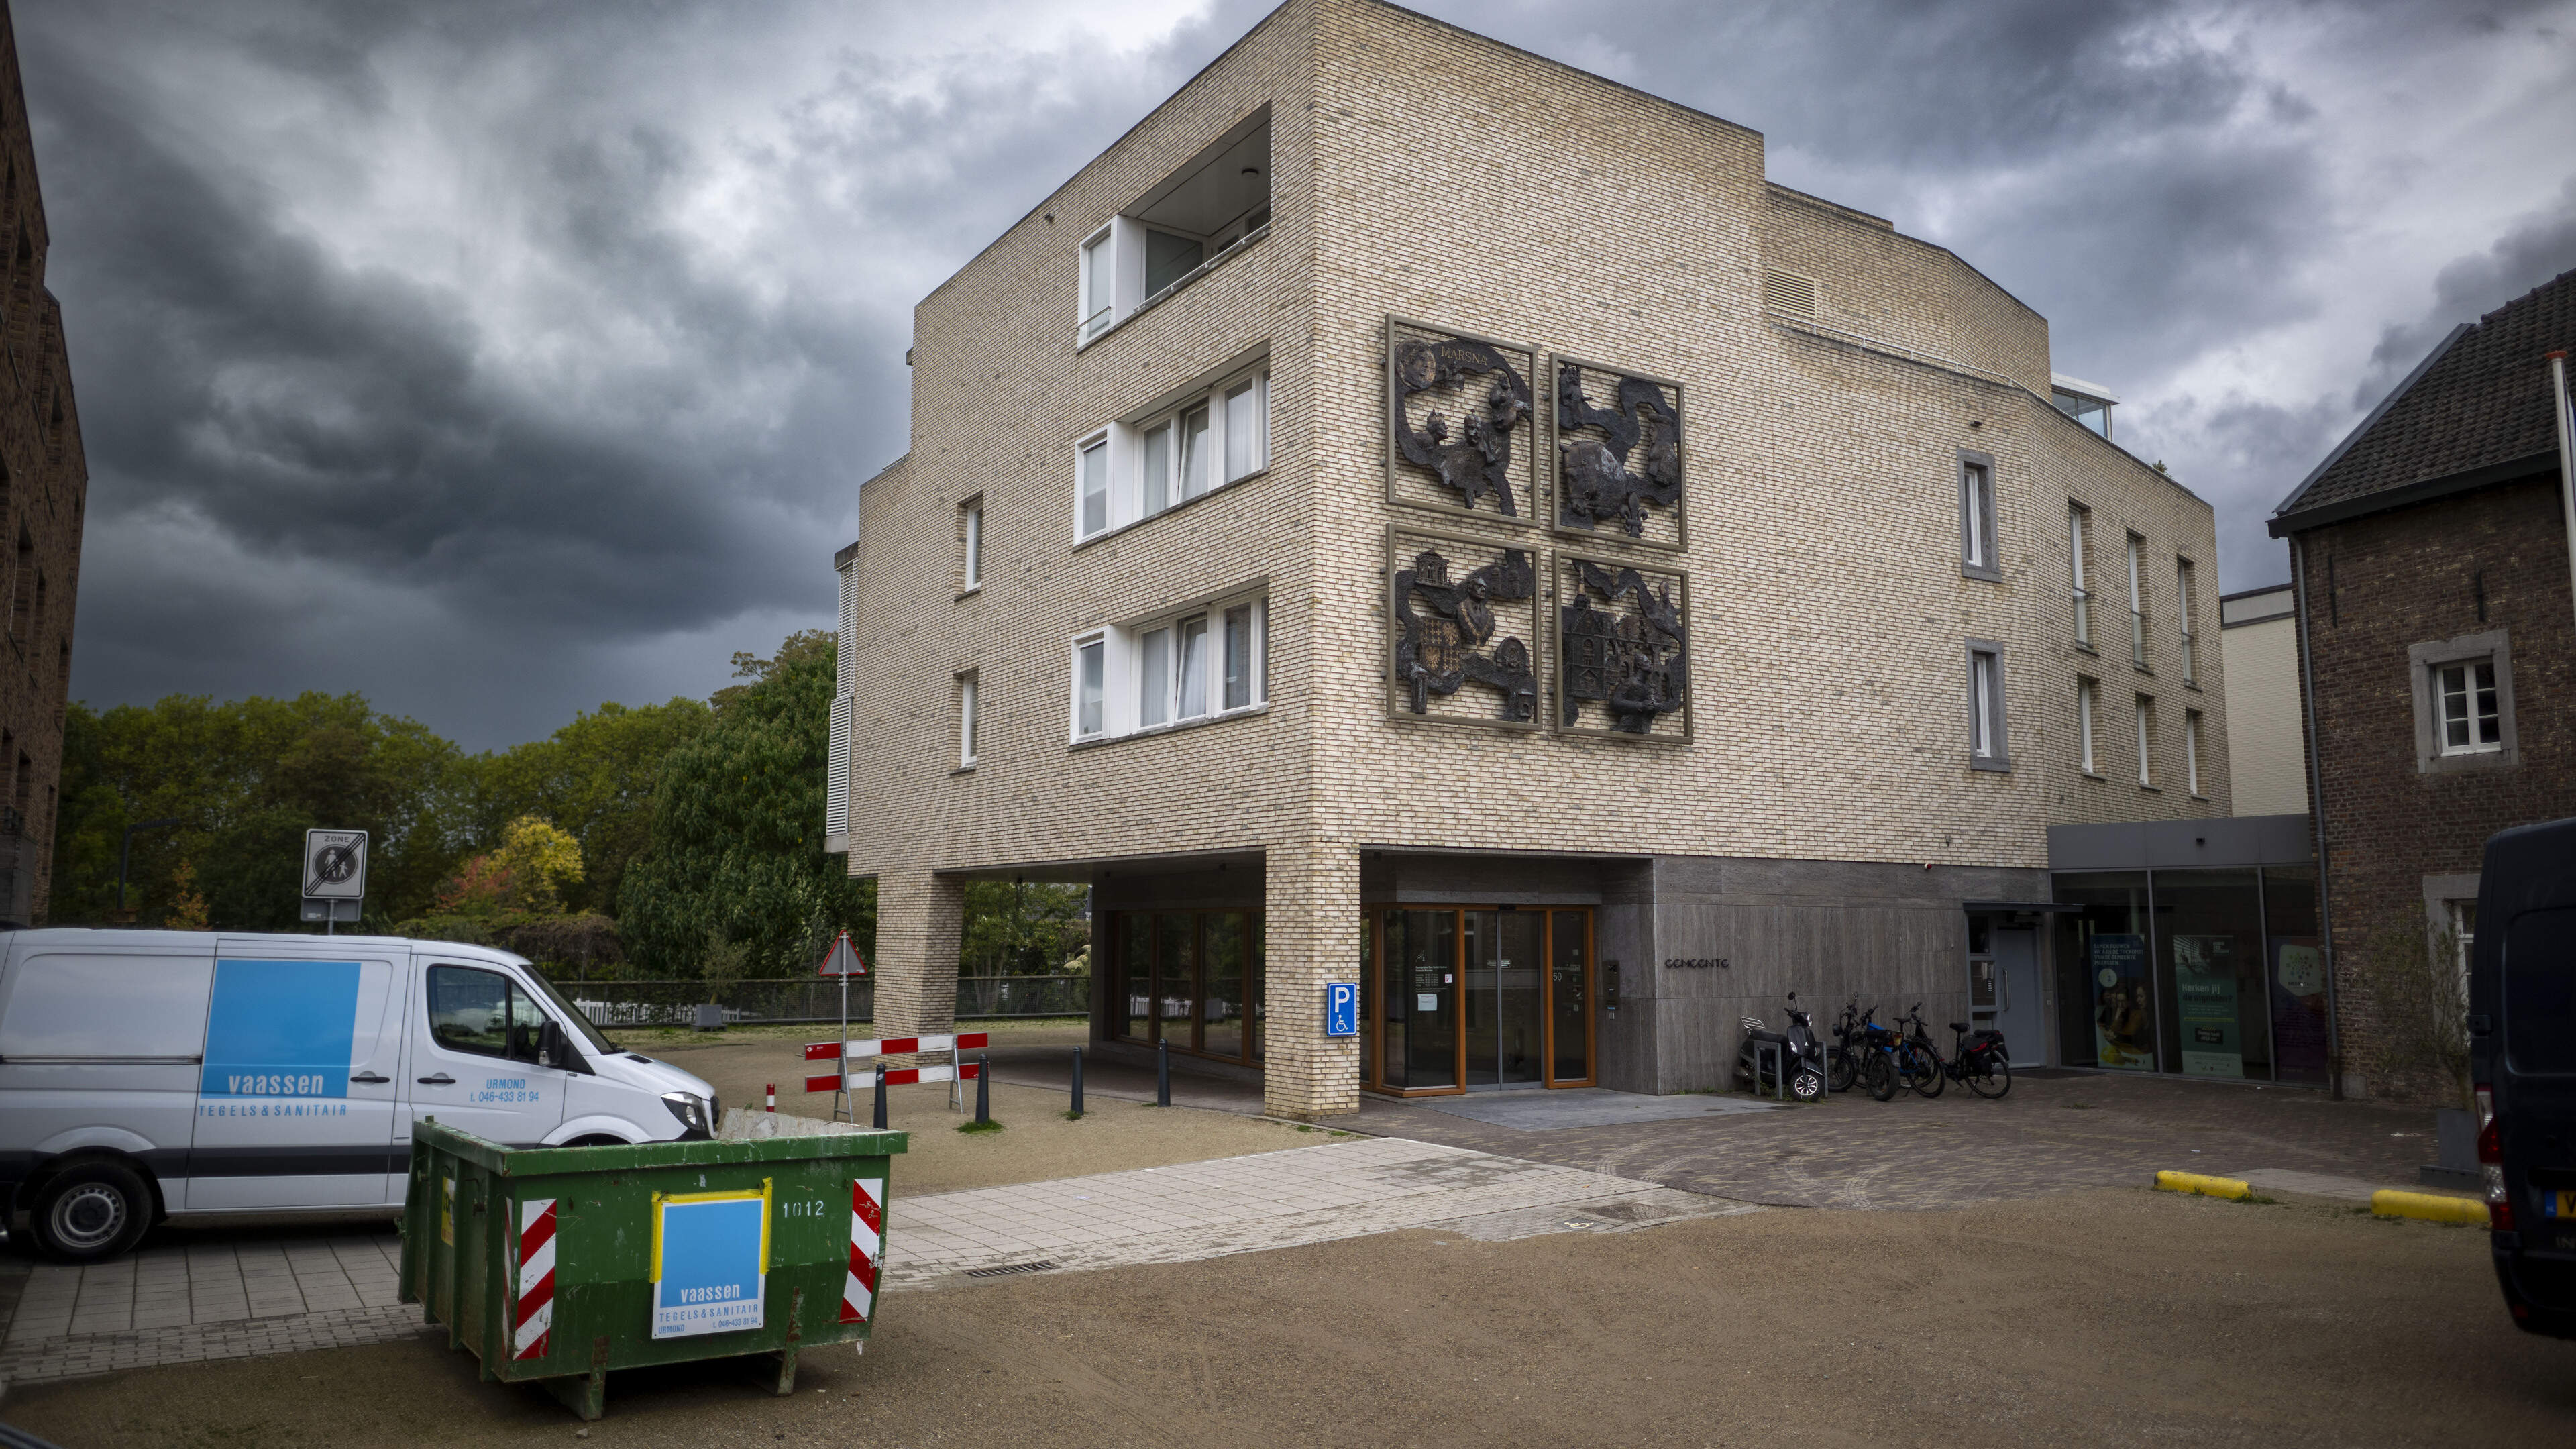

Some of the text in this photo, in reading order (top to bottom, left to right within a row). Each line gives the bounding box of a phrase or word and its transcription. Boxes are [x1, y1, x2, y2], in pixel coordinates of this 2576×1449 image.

[1440, 346, 1487, 366] MARSNA
[1665, 959, 1729, 968] GEMEENTE
[1553, 972, 1562, 981] 50
[2182, 983, 2220, 994] Herken jij
[1334, 987, 1350, 1013] P
[229, 1075, 323, 1095] vaassen
[486, 1079, 525, 1089] URMOND
[470, 1091, 539, 1102] t. 046-433 81 94
[784, 1200, 824, 1218] 1012
[680, 1283, 740, 1303] vaassen
[658, 1324, 685, 1334] URMOND
[718, 1318, 741, 1328] 046-433
